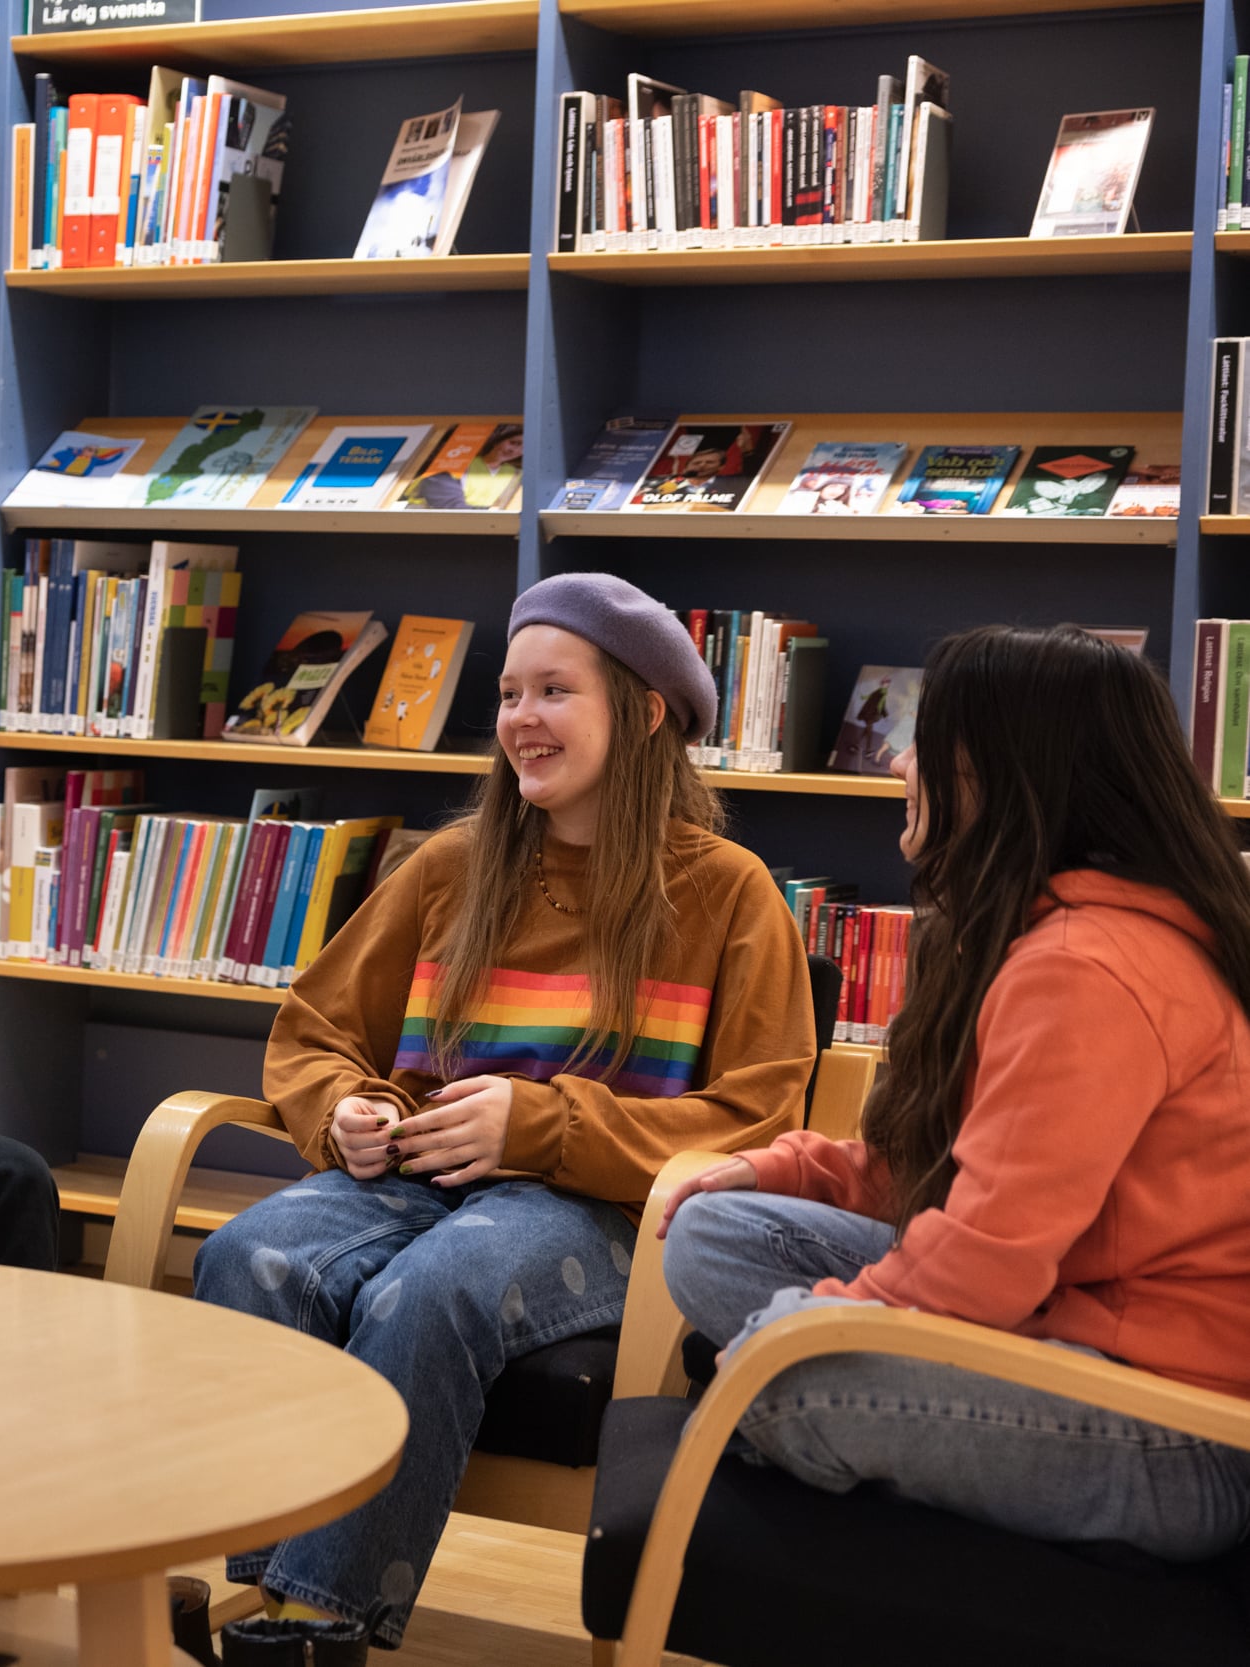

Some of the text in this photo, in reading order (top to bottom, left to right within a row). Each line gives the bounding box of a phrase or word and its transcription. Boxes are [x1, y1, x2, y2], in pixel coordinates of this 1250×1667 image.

[43, 1, 166, 26] Lär dig svenska
[966, 455, 1005, 467] och
[925, 466, 995, 477] semlor
[642, 493, 736, 503] OLOF PALME
[1202, 671, 1213, 703] Religion
